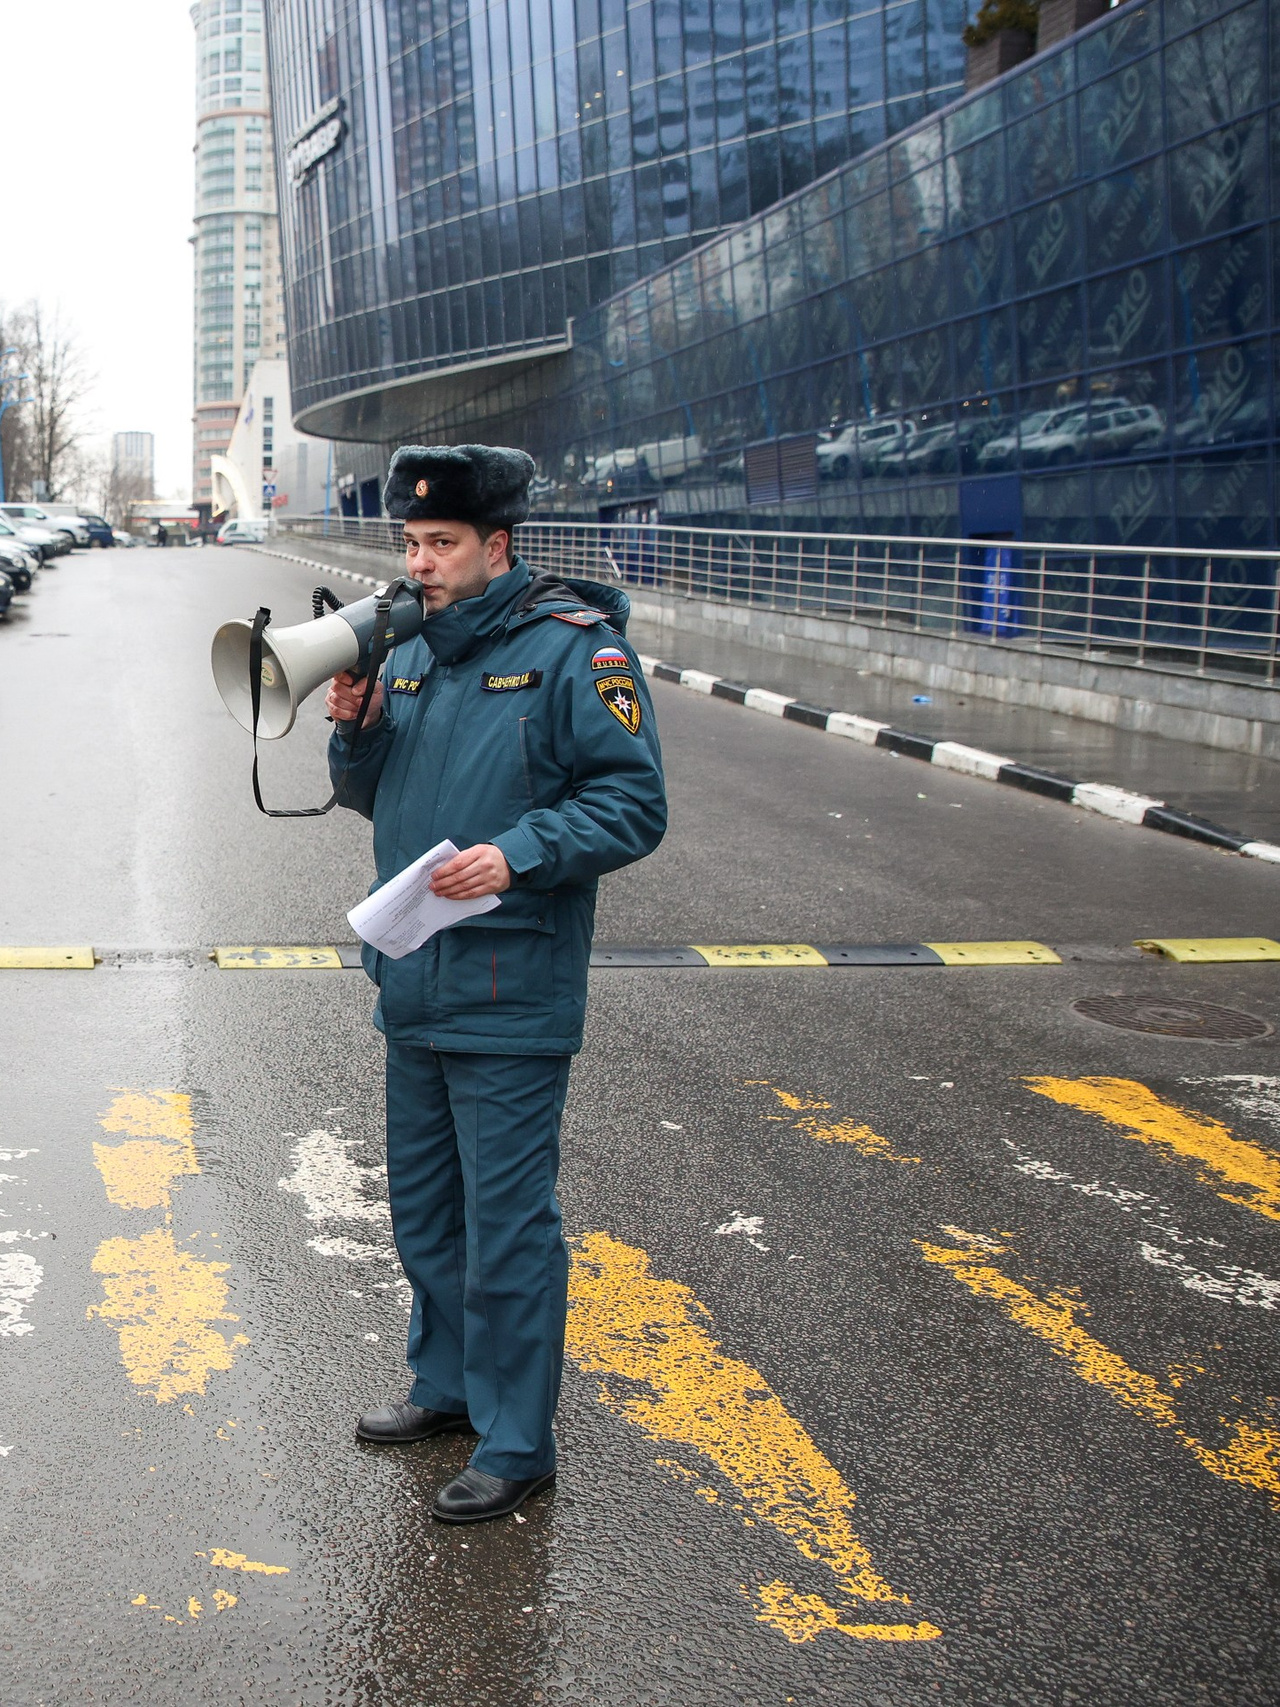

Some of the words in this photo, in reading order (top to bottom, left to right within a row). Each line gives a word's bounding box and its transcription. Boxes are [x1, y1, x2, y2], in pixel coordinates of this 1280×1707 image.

[596, 660, 627, 668] RUSSIA
[393, 678, 409, 690] МЧС
[598, 679, 613, 690] МЧС
[611, 677, 634, 689] РОССИИ
